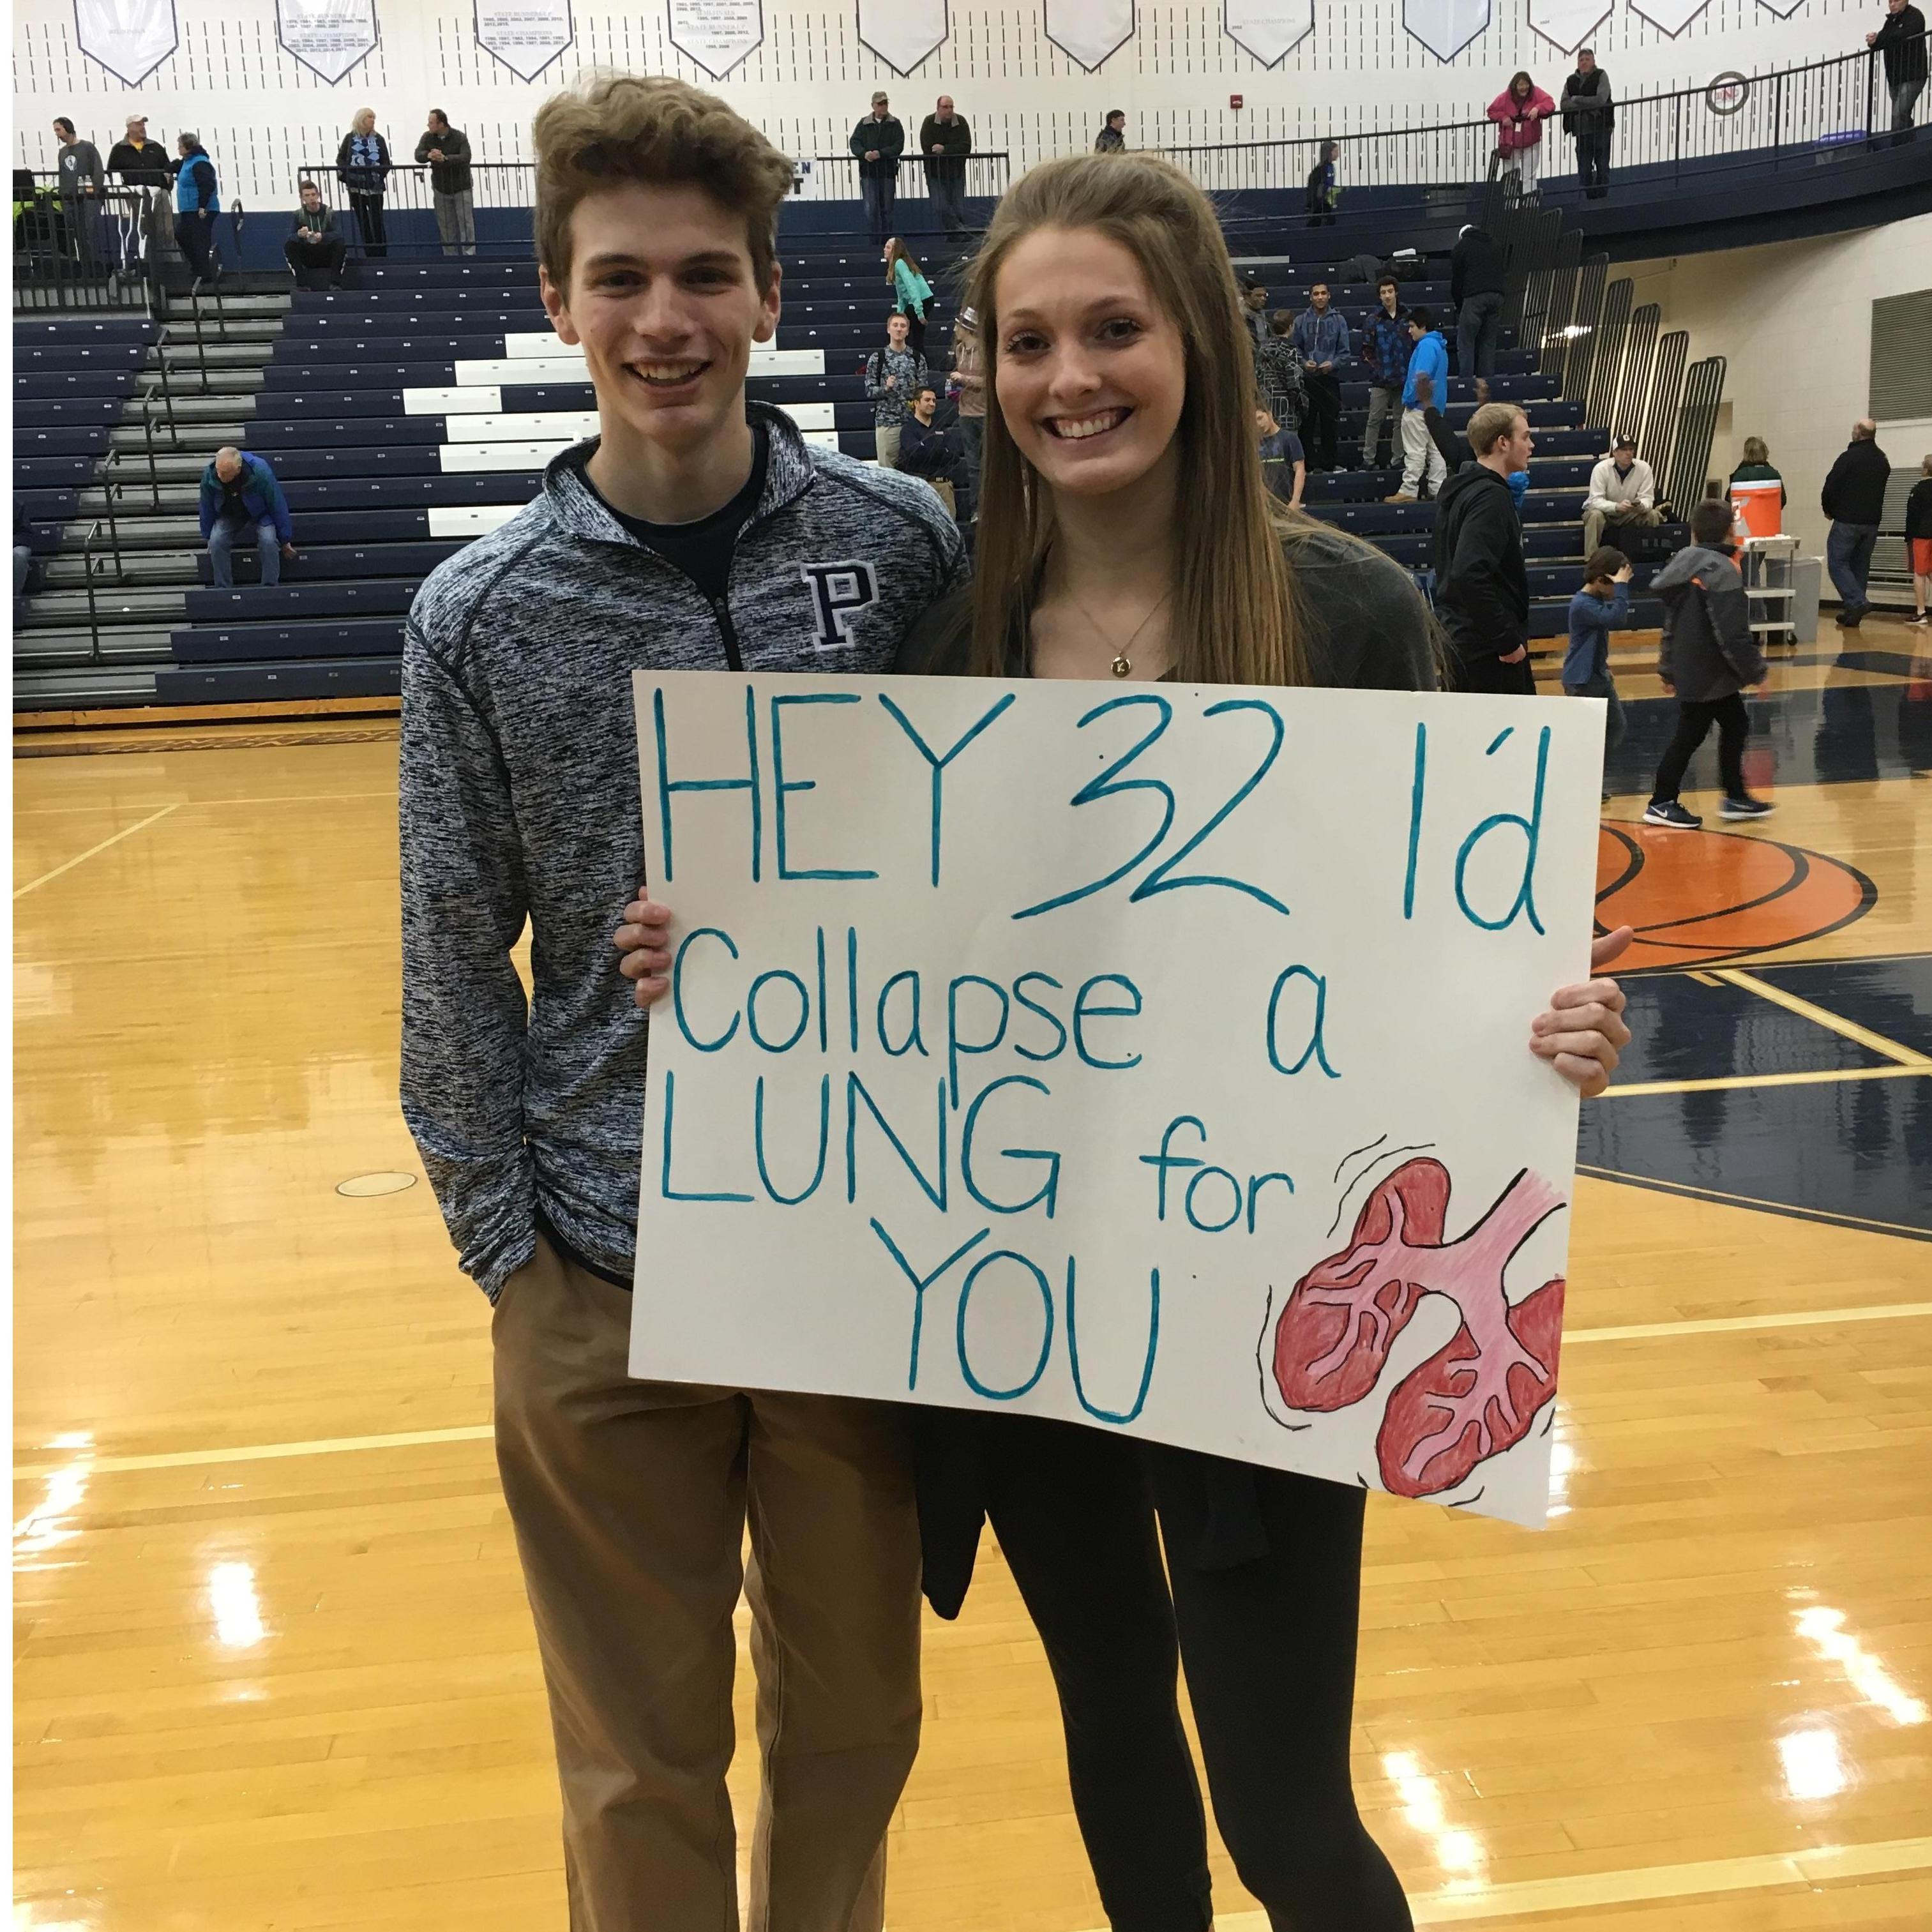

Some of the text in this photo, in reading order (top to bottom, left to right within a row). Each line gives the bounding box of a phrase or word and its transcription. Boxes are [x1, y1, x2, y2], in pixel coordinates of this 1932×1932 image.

[800, 559, 880, 652] P
[654, 684, 1016, 887] HEY
[1013, 694, 1290, 919] 32
[673, 926, 1340, 1110] Collapse a
[661, 1071, 1294, 1234] LUNG for
[870, 1217, 1160, 1425] YOU
